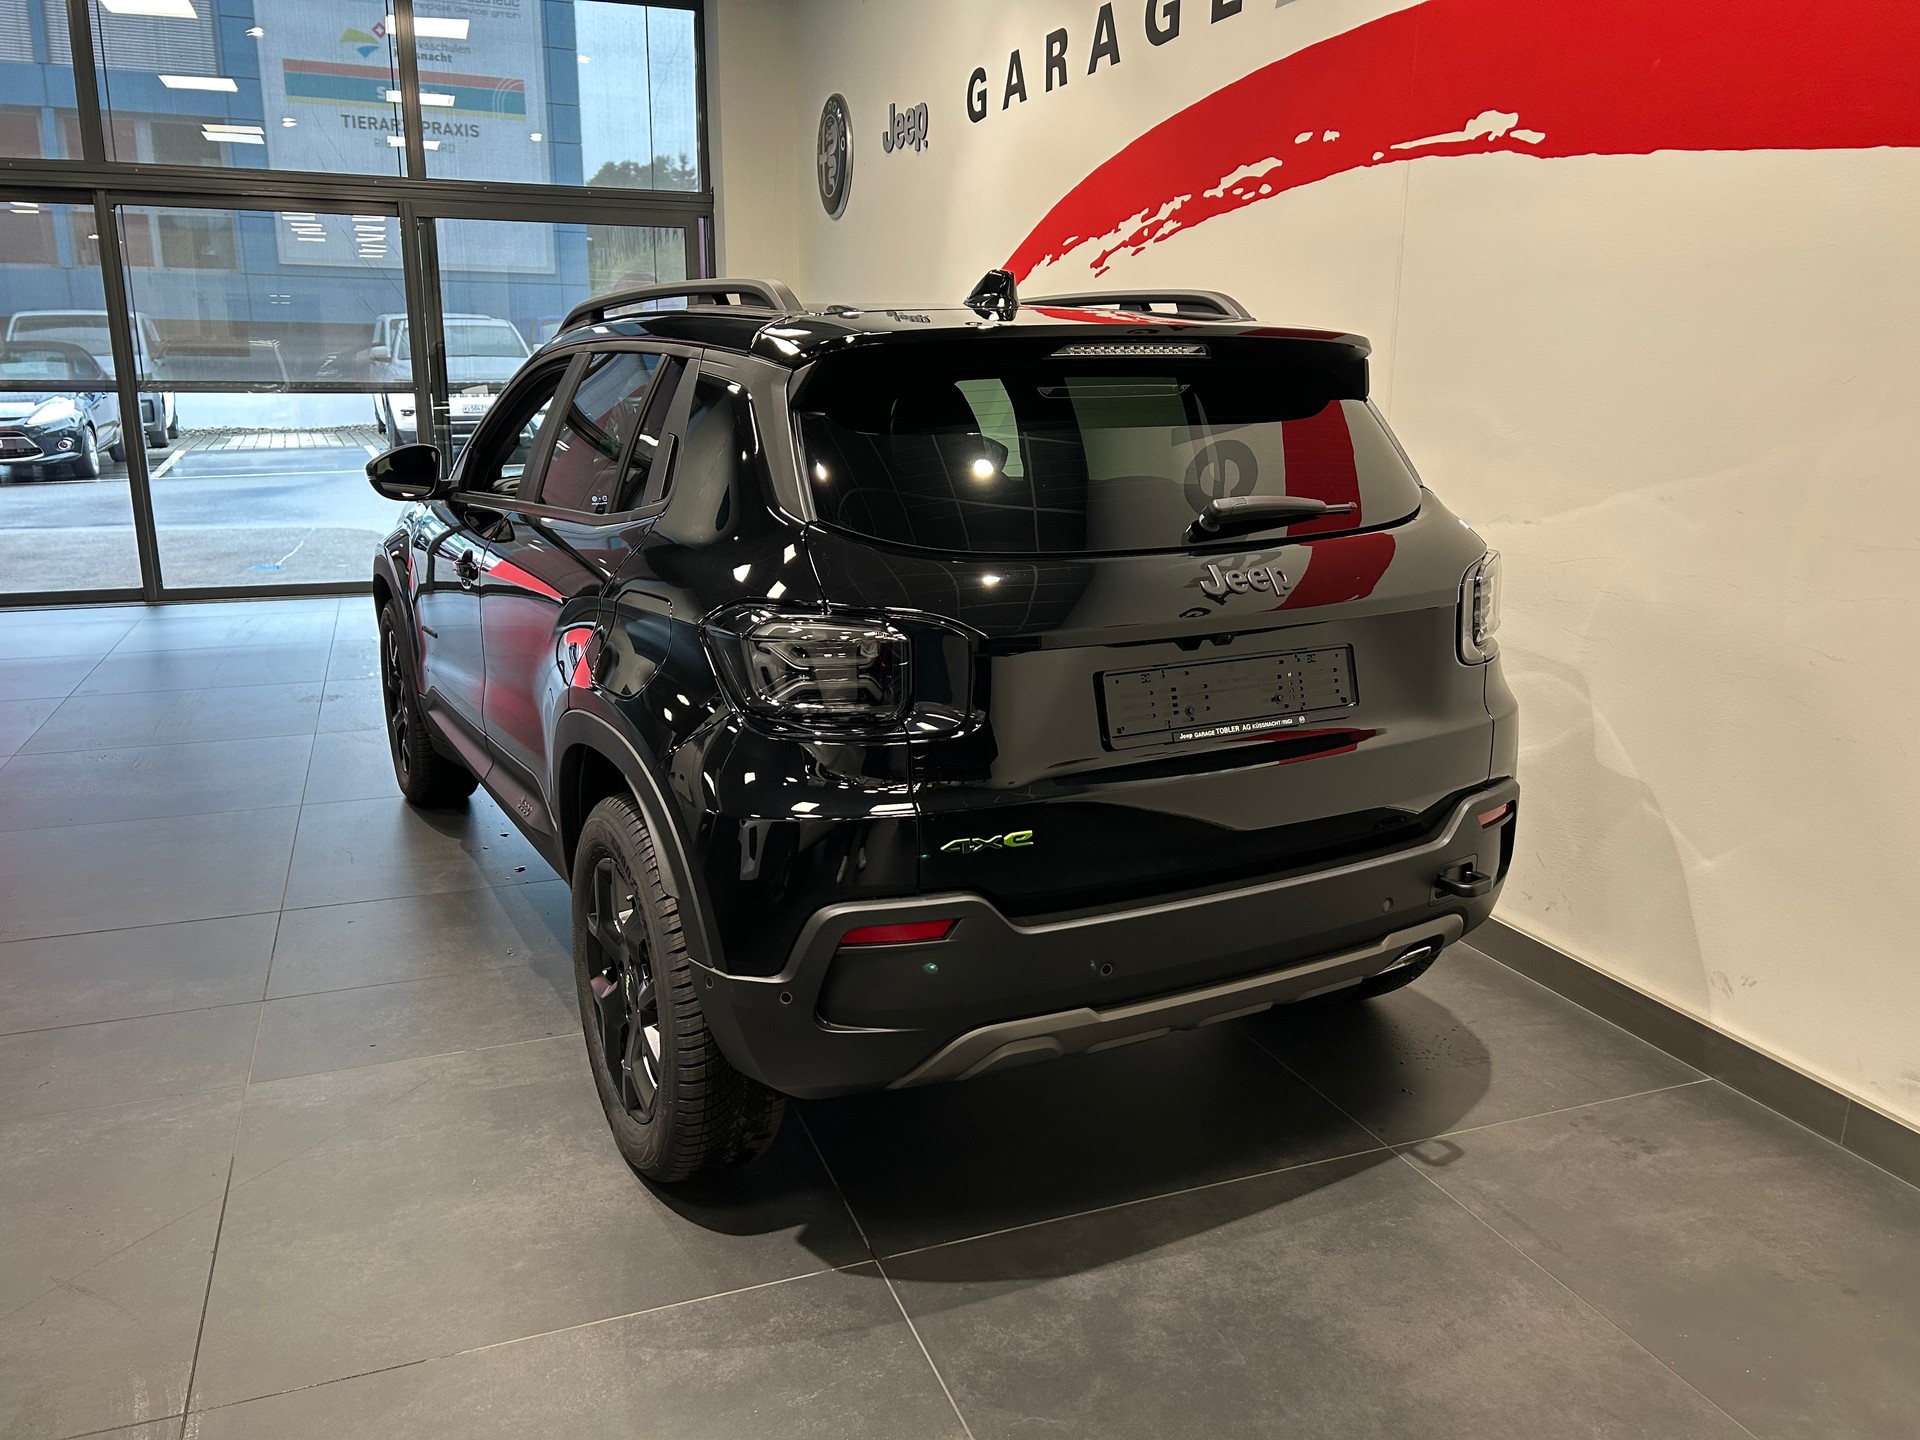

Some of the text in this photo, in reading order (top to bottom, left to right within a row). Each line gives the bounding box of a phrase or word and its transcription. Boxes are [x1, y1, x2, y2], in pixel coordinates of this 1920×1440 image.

[882, 102, 929, 153] Jeep
[1200, 564, 1293, 597] Jeep
[1179, 732, 1193, 740] Jeep
[1194, 729, 1215, 738] GARAGE
[1215, 725, 1240, 735] TOBLER
[1242, 723, 1251, 731] AG
